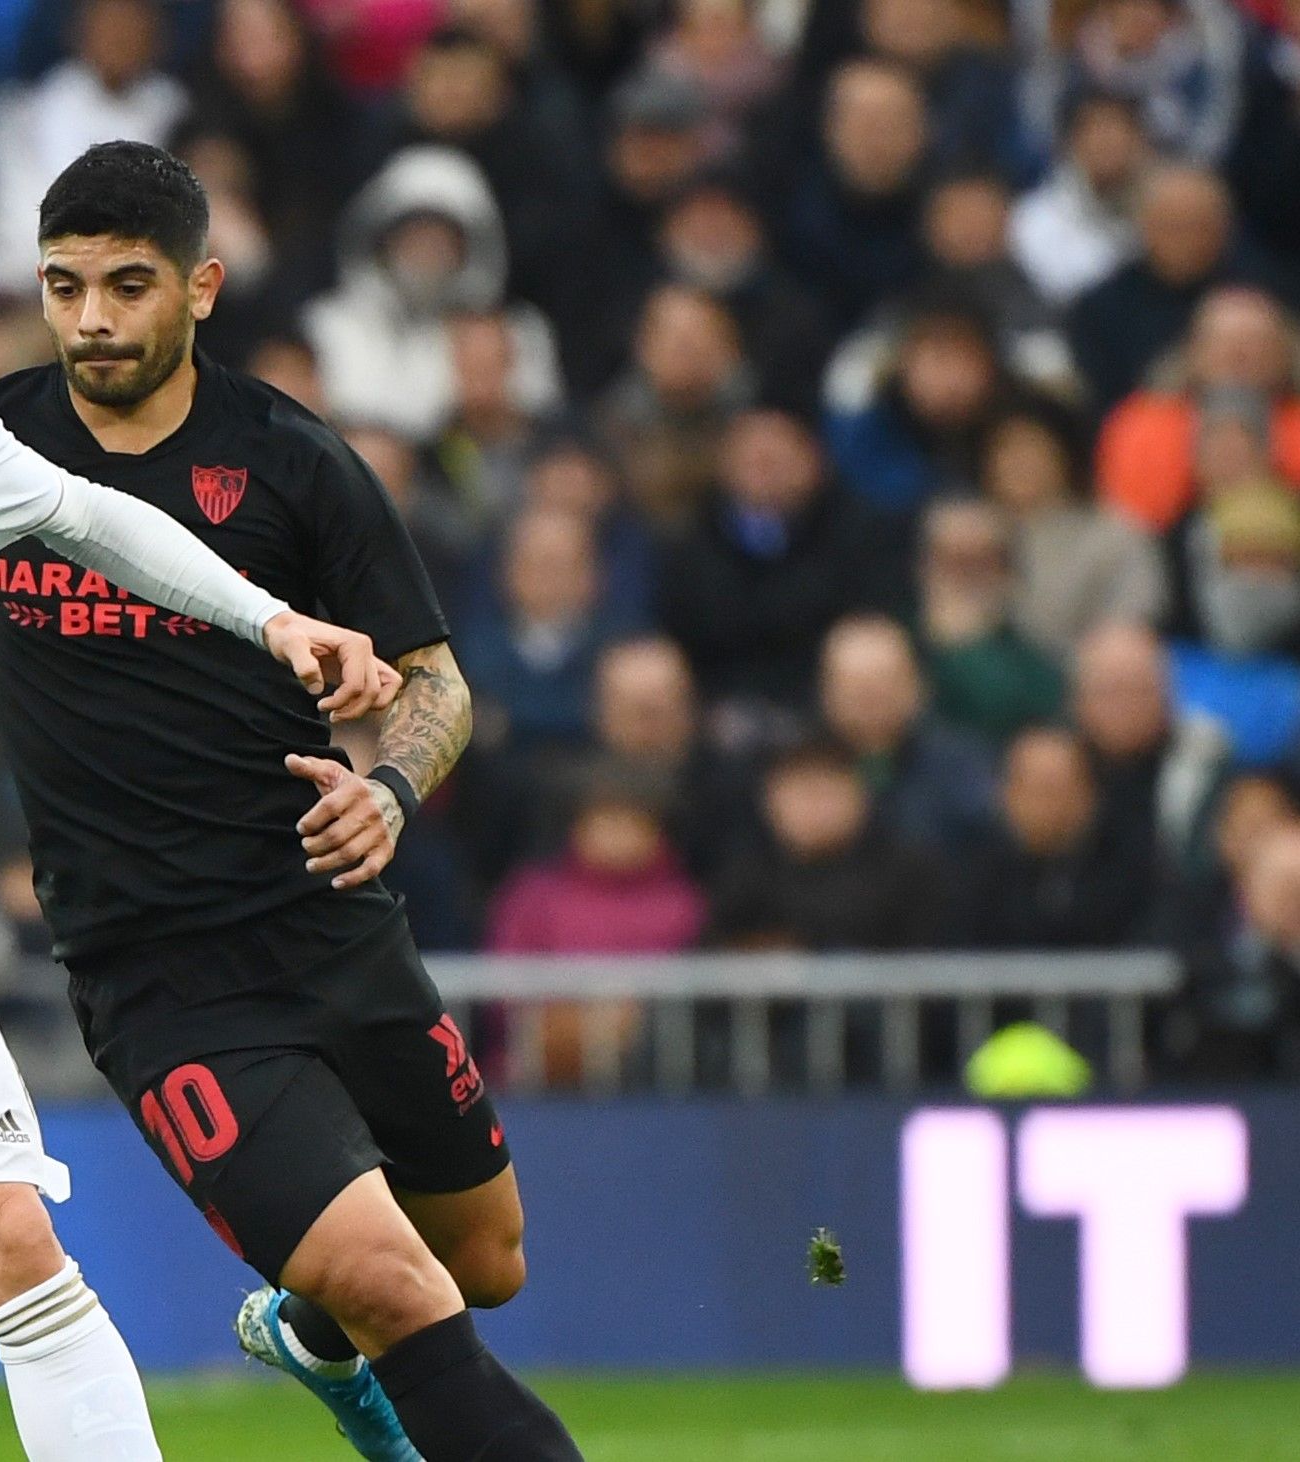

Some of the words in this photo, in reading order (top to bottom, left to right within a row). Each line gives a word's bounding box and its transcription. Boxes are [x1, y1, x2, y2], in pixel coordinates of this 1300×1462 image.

[60, 602, 156, 638] BET
[140, 1062, 240, 1187] 10
[900, 1106, 1250, 1392] IT
